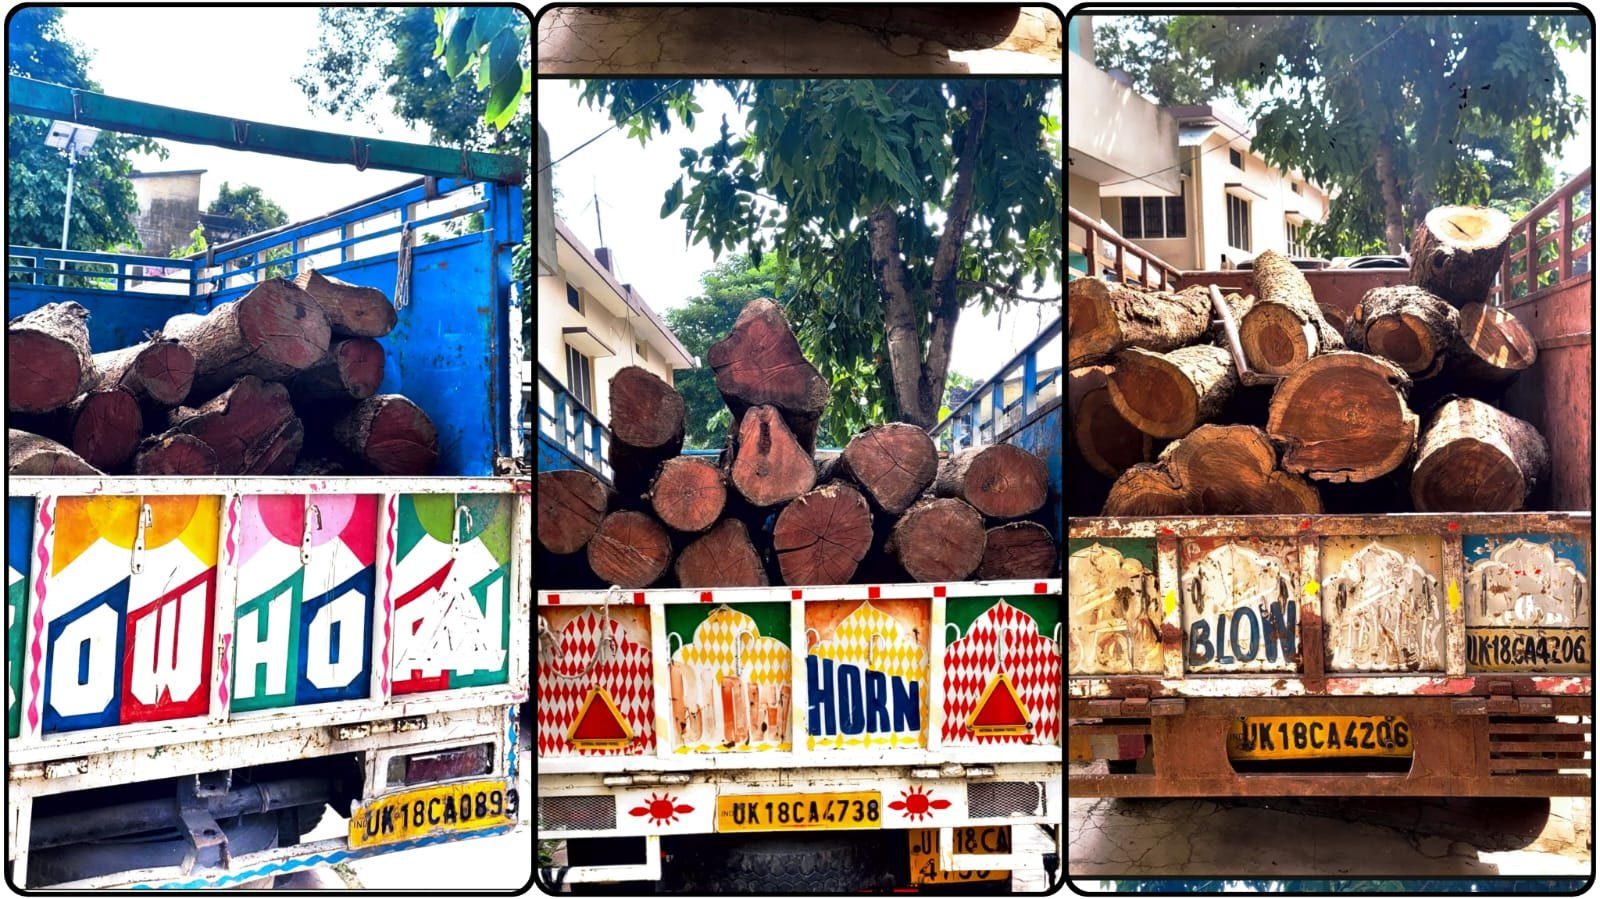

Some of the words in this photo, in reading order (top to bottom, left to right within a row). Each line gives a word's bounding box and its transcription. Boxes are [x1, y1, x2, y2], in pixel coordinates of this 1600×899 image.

[9, 580, 209, 718] OW
[1189, 600, 1297, 666] BLOW
[807, 654, 921, 736] HORN
[1242, 721, 1409, 751] UK18CA4206
[733, 799, 880, 825] UK18CA4738
